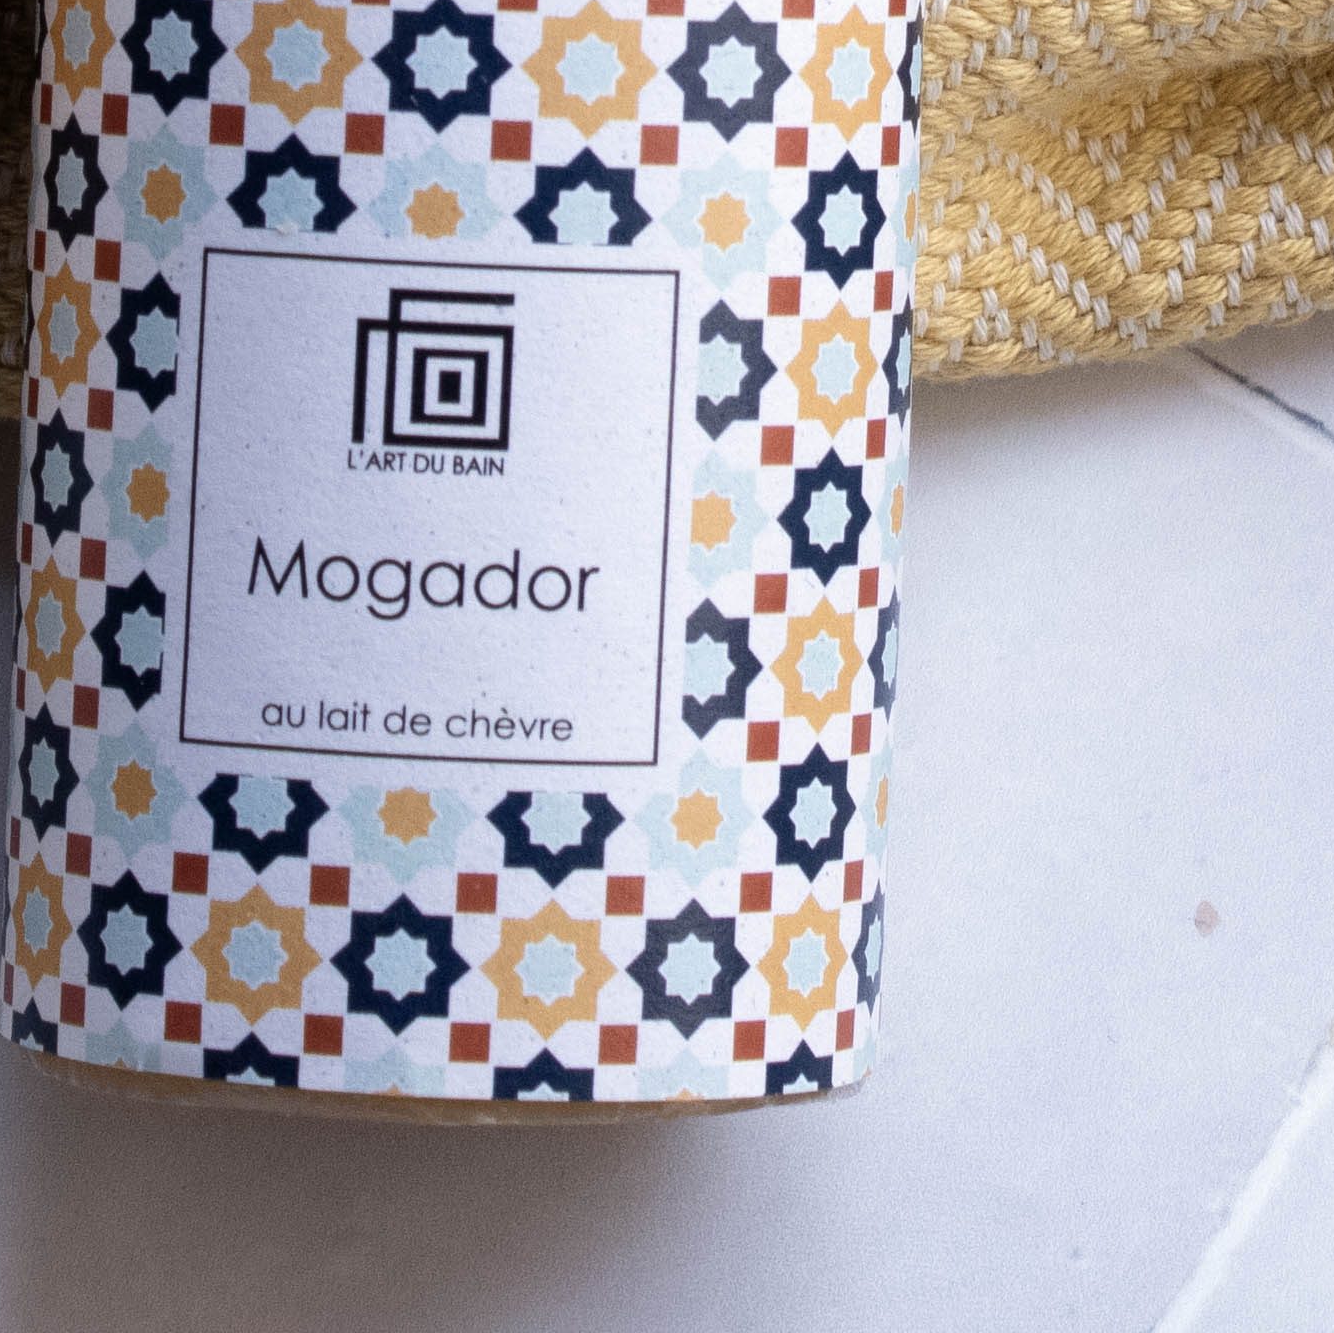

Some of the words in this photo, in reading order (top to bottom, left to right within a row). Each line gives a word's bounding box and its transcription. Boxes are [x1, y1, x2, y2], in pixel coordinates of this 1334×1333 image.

[347, 449, 406, 471] L'ART
[412, 452, 445, 475] DU
[452, 455, 505, 476] BAIN
[247, 535, 599, 621] Mogador
[261, 703, 306, 729] au
[318, 700, 371, 732] lait
[382, 705, 432, 736] de
[445, 707, 573, 741] chèvre
